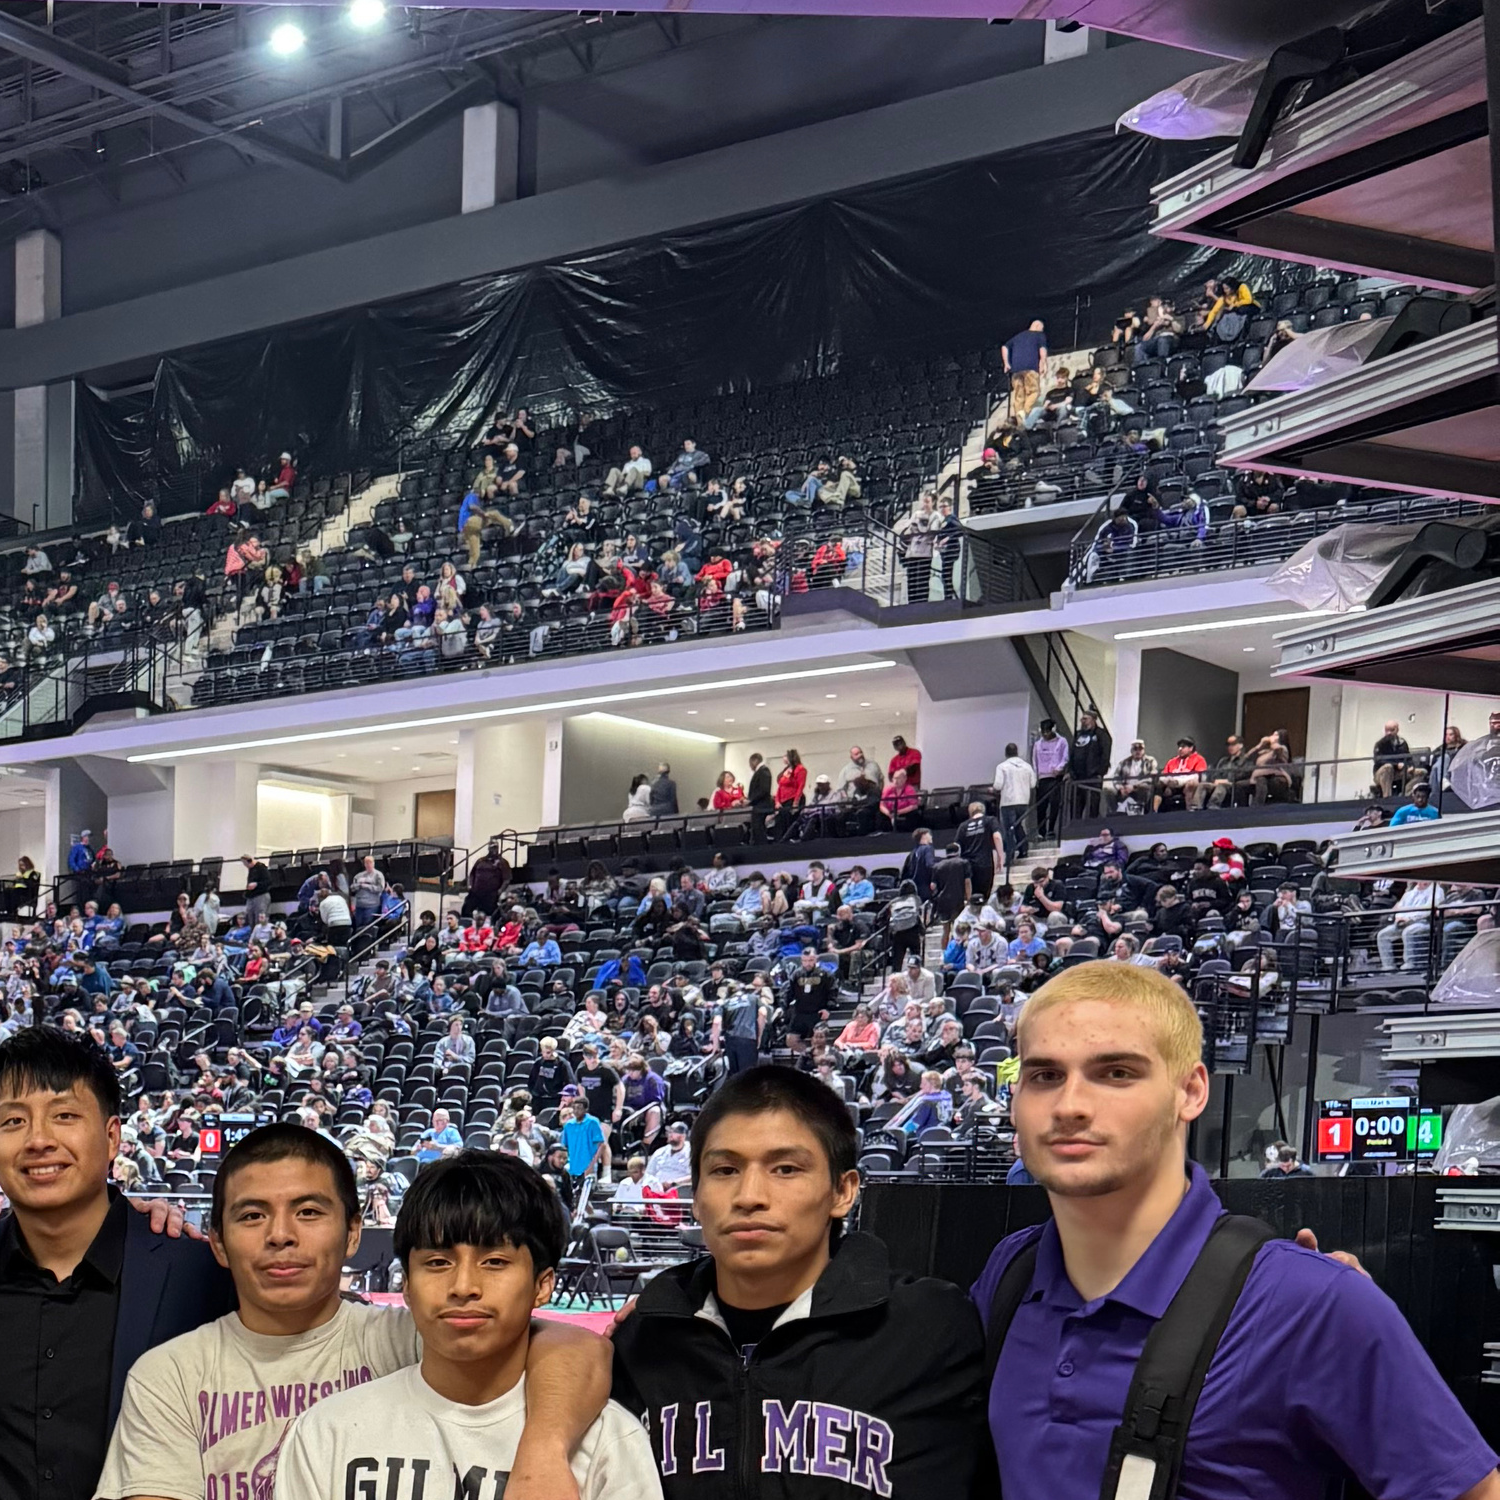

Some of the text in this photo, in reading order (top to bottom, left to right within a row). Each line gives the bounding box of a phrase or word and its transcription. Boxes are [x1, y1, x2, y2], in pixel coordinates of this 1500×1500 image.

[1328, 1123, 1341, 1146] 1
[1355, 1115, 1405, 1136] 0:00
[1418, 1120, 1433, 1144] 4
[205, 1132, 216, 1148] 0
